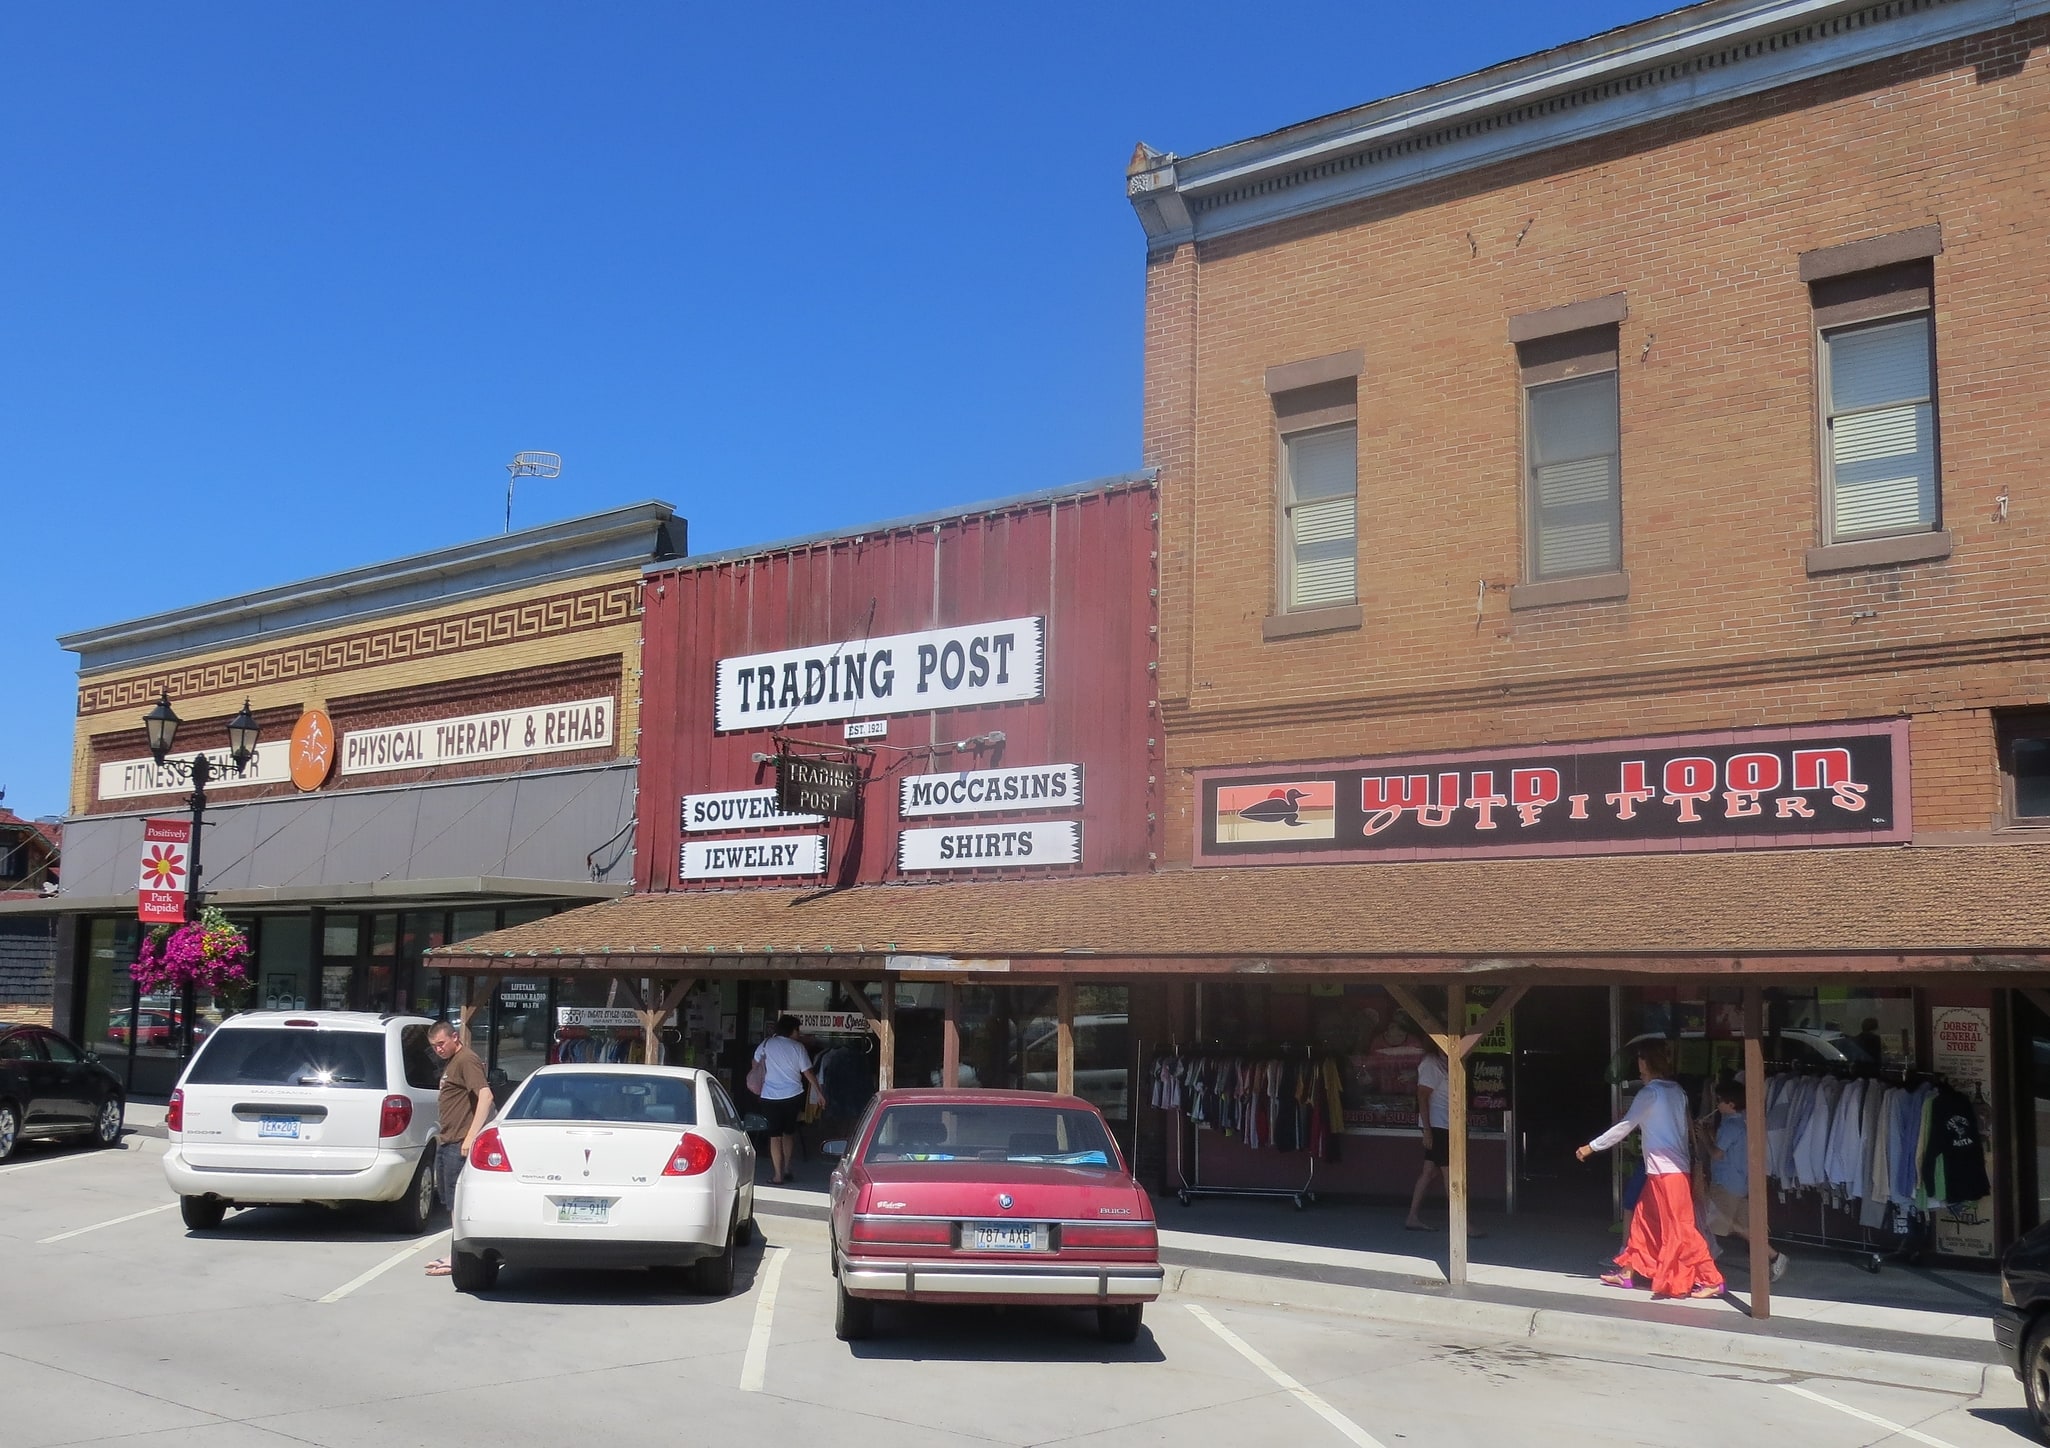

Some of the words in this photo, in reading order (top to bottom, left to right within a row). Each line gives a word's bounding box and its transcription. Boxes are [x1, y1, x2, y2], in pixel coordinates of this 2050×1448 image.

[737, 649, 895, 713] TRADING
[916, 632, 1015, 694] POST
[348, 729, 424, 767] PHYSICAL
[436, 718, 511, 758] THERAPY
[524, 714, 537, 748] &
[545, 705, 605, 745] REHAB
[847, 725, 866, 736] EST.
[867, 722, 884, 735] 1921
[124, 760, 186, 792] FITNESS
[788, 763, 854, 789] TRADING
[1361, 767, 1560, 812] WILD
[1620, 747, 1851, 797] LOON
[912, 772, 1067, 807] MOCCASINS
[694, 795, 812, 823] SOUVEN
[800, 791, 841, 812] POST
[1362, 780, 1868, 837] OUTFITTERS
[147, 828, 187, 840] Positively
[940, 831, 1033, 860] SHIRTS
[705, 843, 799, 870] JEWELRY
[151, 892, 173, 902] Park
[144, 902, 179, 914] Rapids!
[529, 992, 546, 1001] RADIO
[562, 1013, 581, 1025] 200
[805, 1014, 818, 1026] POST
[832, 1015, 844, 1027] DOT
[1943, 1021, 1980, 1032] DORSET
[1940, 1032, 1983, 1042] GENERAL
[1946, 1041, 1976, 1052] STORE
[978, 1228, 999, 1243] 787
[1009, 1228, 1030, 1243] AXB
